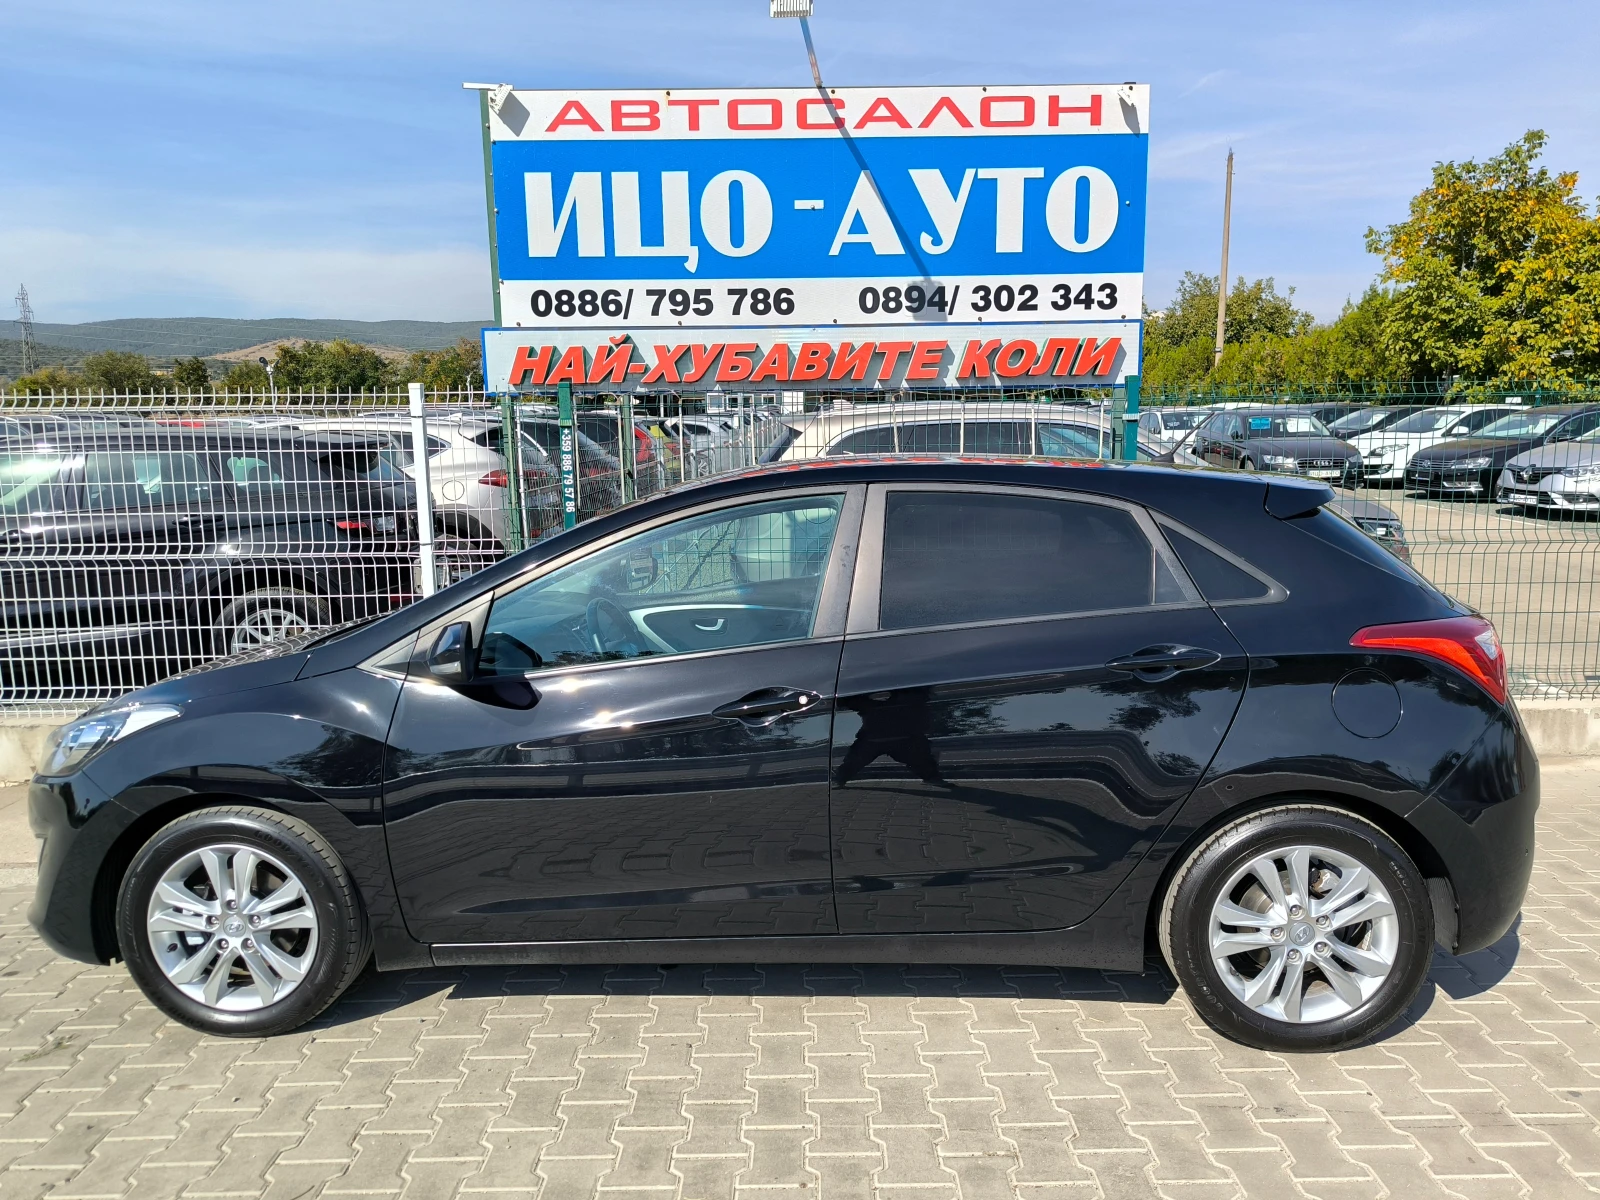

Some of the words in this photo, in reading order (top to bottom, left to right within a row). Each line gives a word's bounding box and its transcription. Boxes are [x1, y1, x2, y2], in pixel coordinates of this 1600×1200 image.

[546, 94, 1103, 133] АВТОСАЛОН
[524, 170, 773, 273] ИЦО
[530, 288, 634, 320] 0886/
[645, 288, 714, 317] 795
[727, 287, 795, 316] 786
[858, 285, 960, 316] 0894/
[970, 284, 1039, 313] 302
[1050, 282, 1118, 311] 343
[509, 333, 948, 386] НАЙ-ХУБАВИТЕ
[955, 337, 1122, 379] КОЛИ
[562, 428, 572, 452] +359
[562, 454, 572, 471] 886
[563, 473, 573, 485] 79
[564, 487, 574, 499] 57
[565, 501, 575, 513] 86
